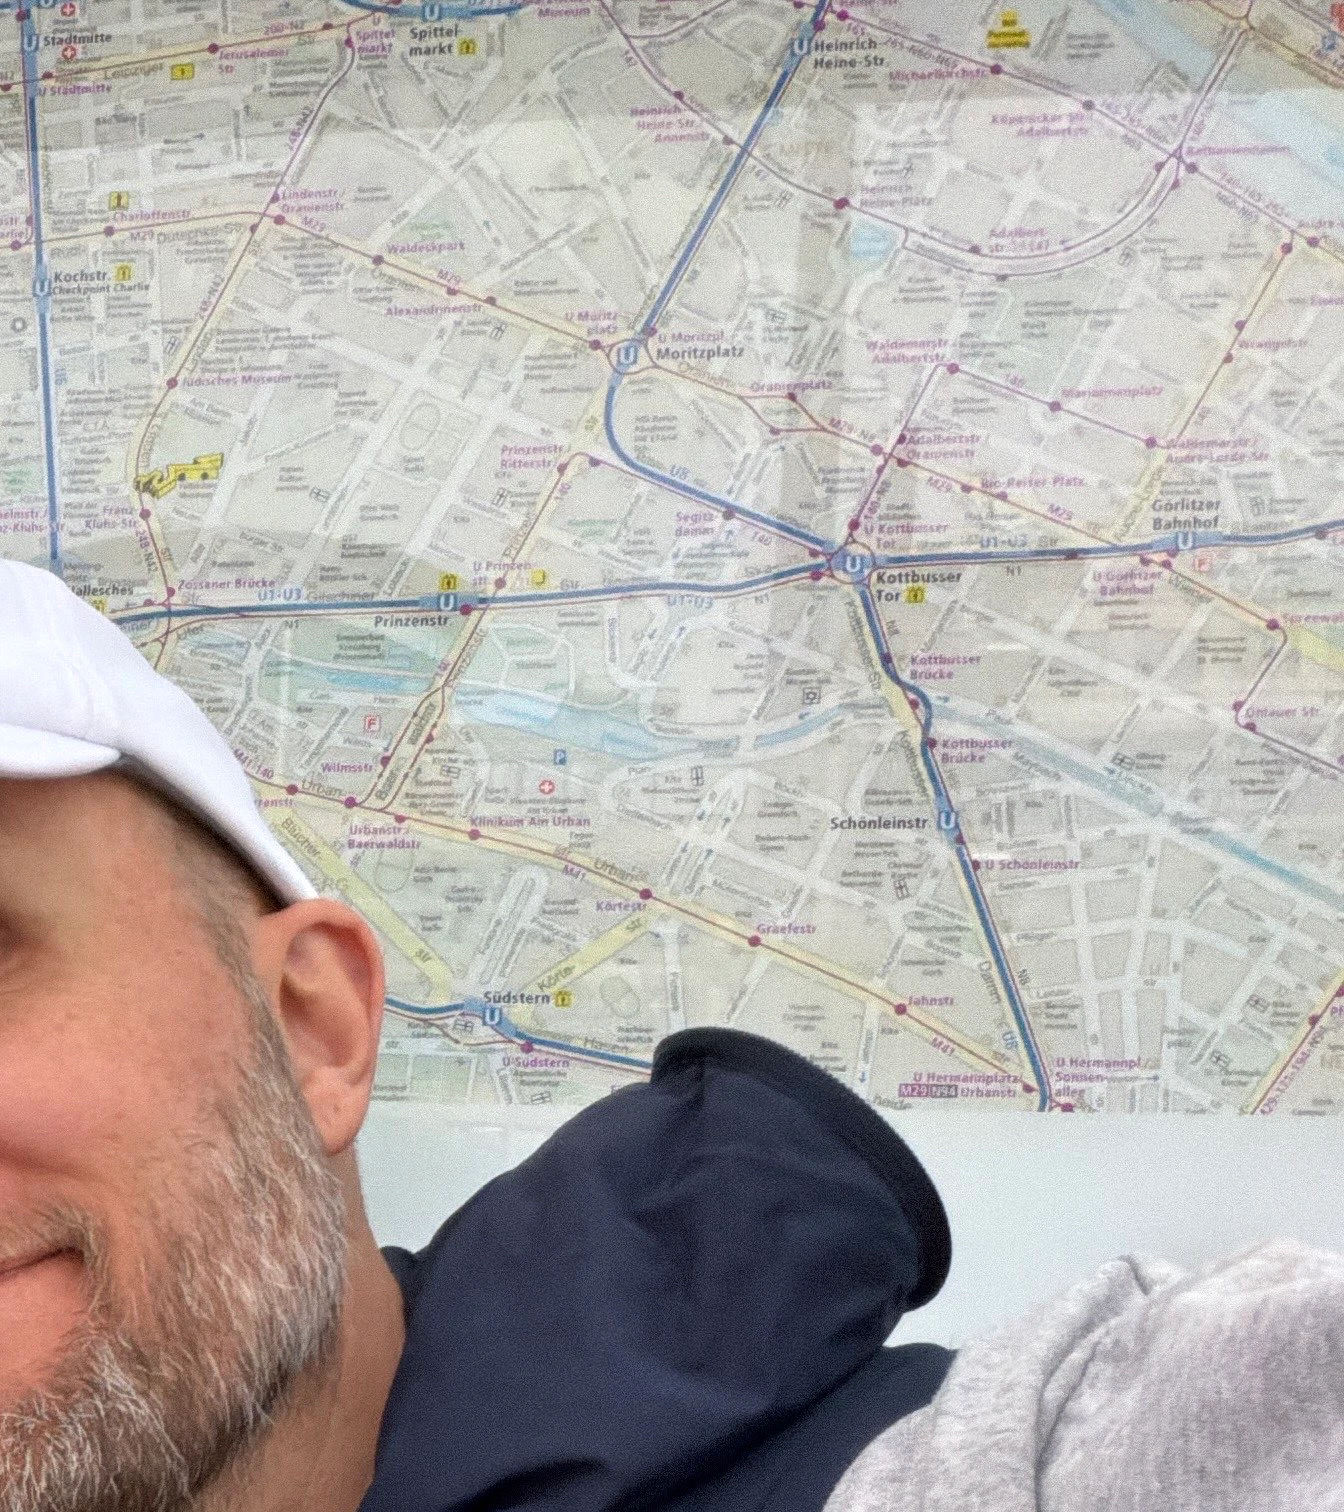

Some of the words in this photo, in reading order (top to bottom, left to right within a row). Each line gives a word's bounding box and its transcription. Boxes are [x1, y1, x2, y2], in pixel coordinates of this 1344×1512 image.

[44, 31, 113, 47] Stadtmitte
[409, 41, 454, 55] markt
[50, 83, 113, 95] Stadtmitte
[388, 240, 465, 255] Waldeckpark
[52, 283, 110, 296] Checkpoint
[114, 281, 150, 292] Charlie
[656, 344, 744, 361] Moritzplatz
[241, 373, 292, 387] Museum
[1152, 498, 1221, 514] Görlitzer
[1153, 515, 1220, 531] Bahnhof
[177, 578, 230, 591] Zossener
[232, 578, 276, 590] Brücke
[876, 570, 962, 585] Kottbusser
[876, 587, 901, 601] Tor
[911, 653, 982, 667] Kottbusser
[911, 668, 954, 681] Brücke
[942, 737, 1013, 750] Kottbusser
[942, 751, 986, 764] Brücke
[552, 814, 591, 827] Urban
[482, 990, 551, 1006] Südstern
